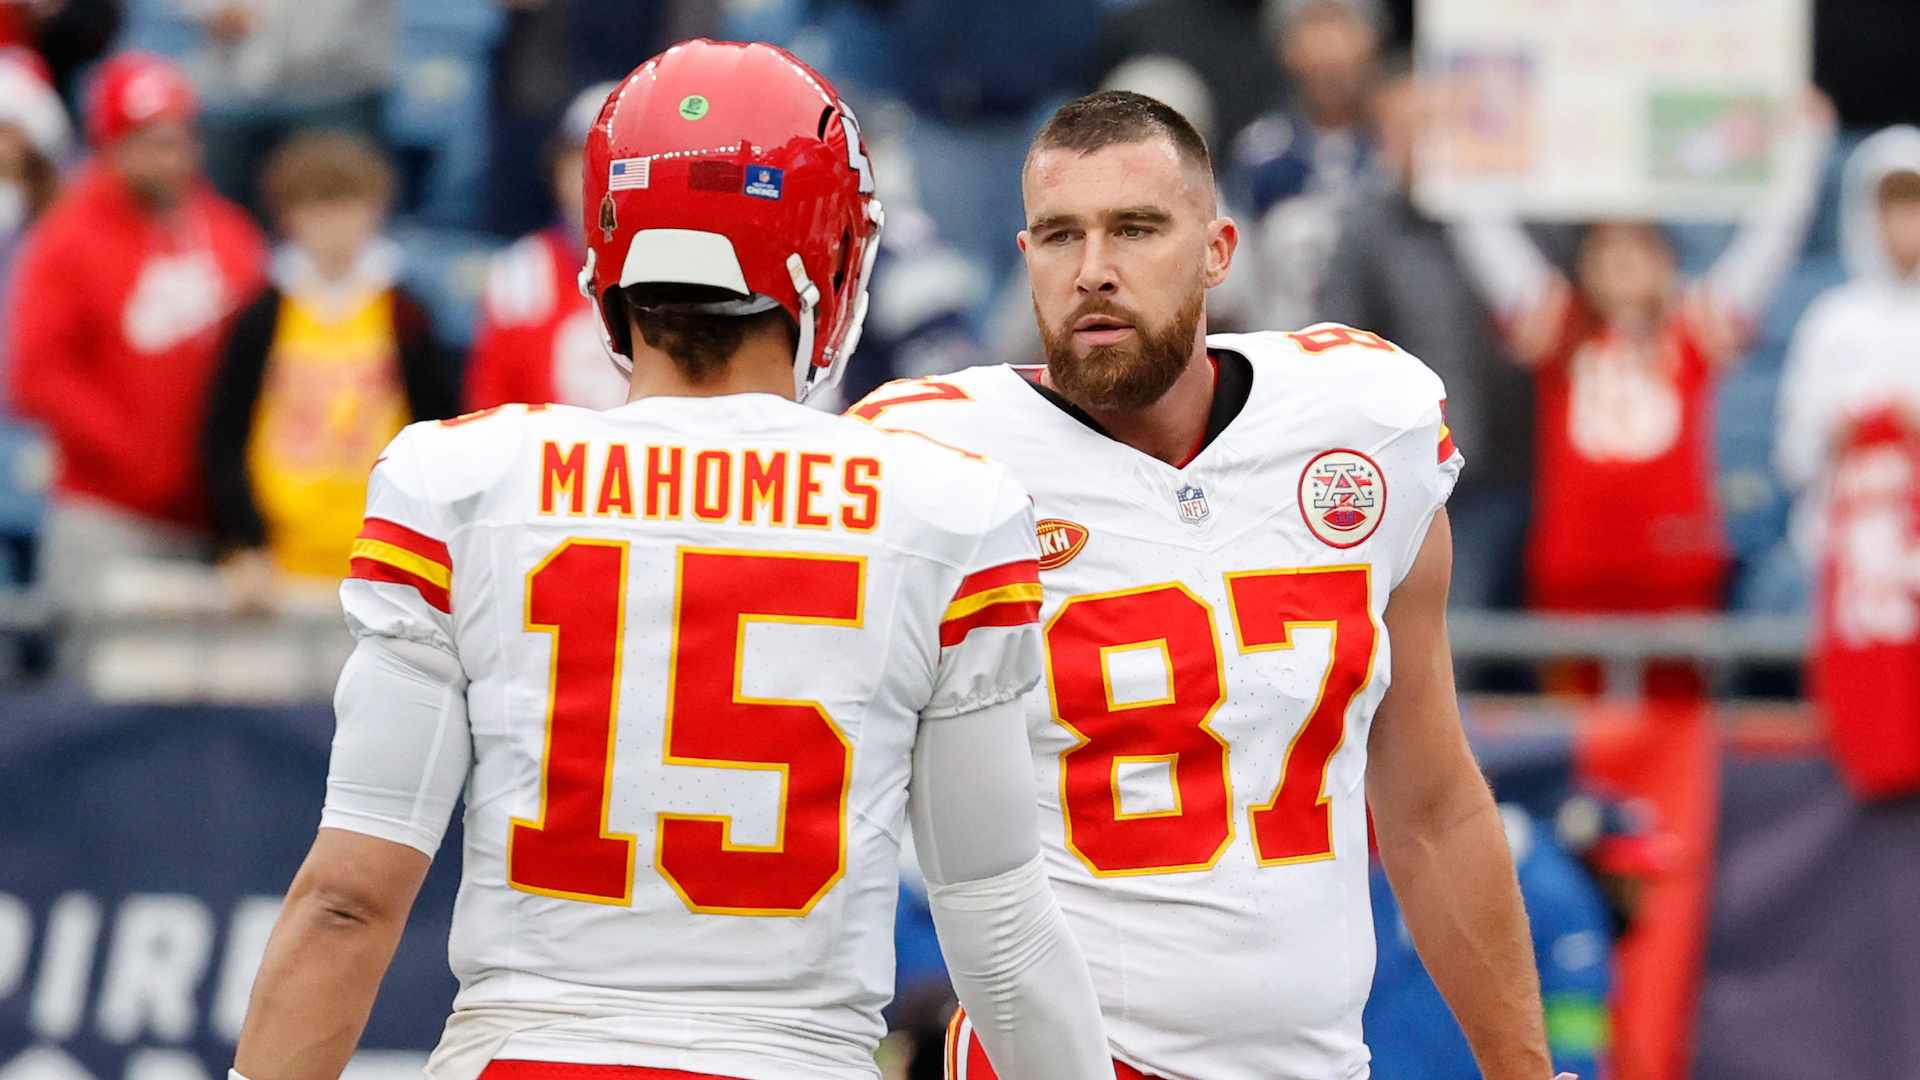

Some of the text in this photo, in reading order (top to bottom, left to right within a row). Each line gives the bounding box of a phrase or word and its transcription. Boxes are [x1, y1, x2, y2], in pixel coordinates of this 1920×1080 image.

[538, 440, 882, 534] MAHOMES
[1182, 500, 1207, 518] NFL
[1038, 527, 1071, 557] KH
[507, 536, 868, 918] 15
[1043, 563, 1379, 878] 87
